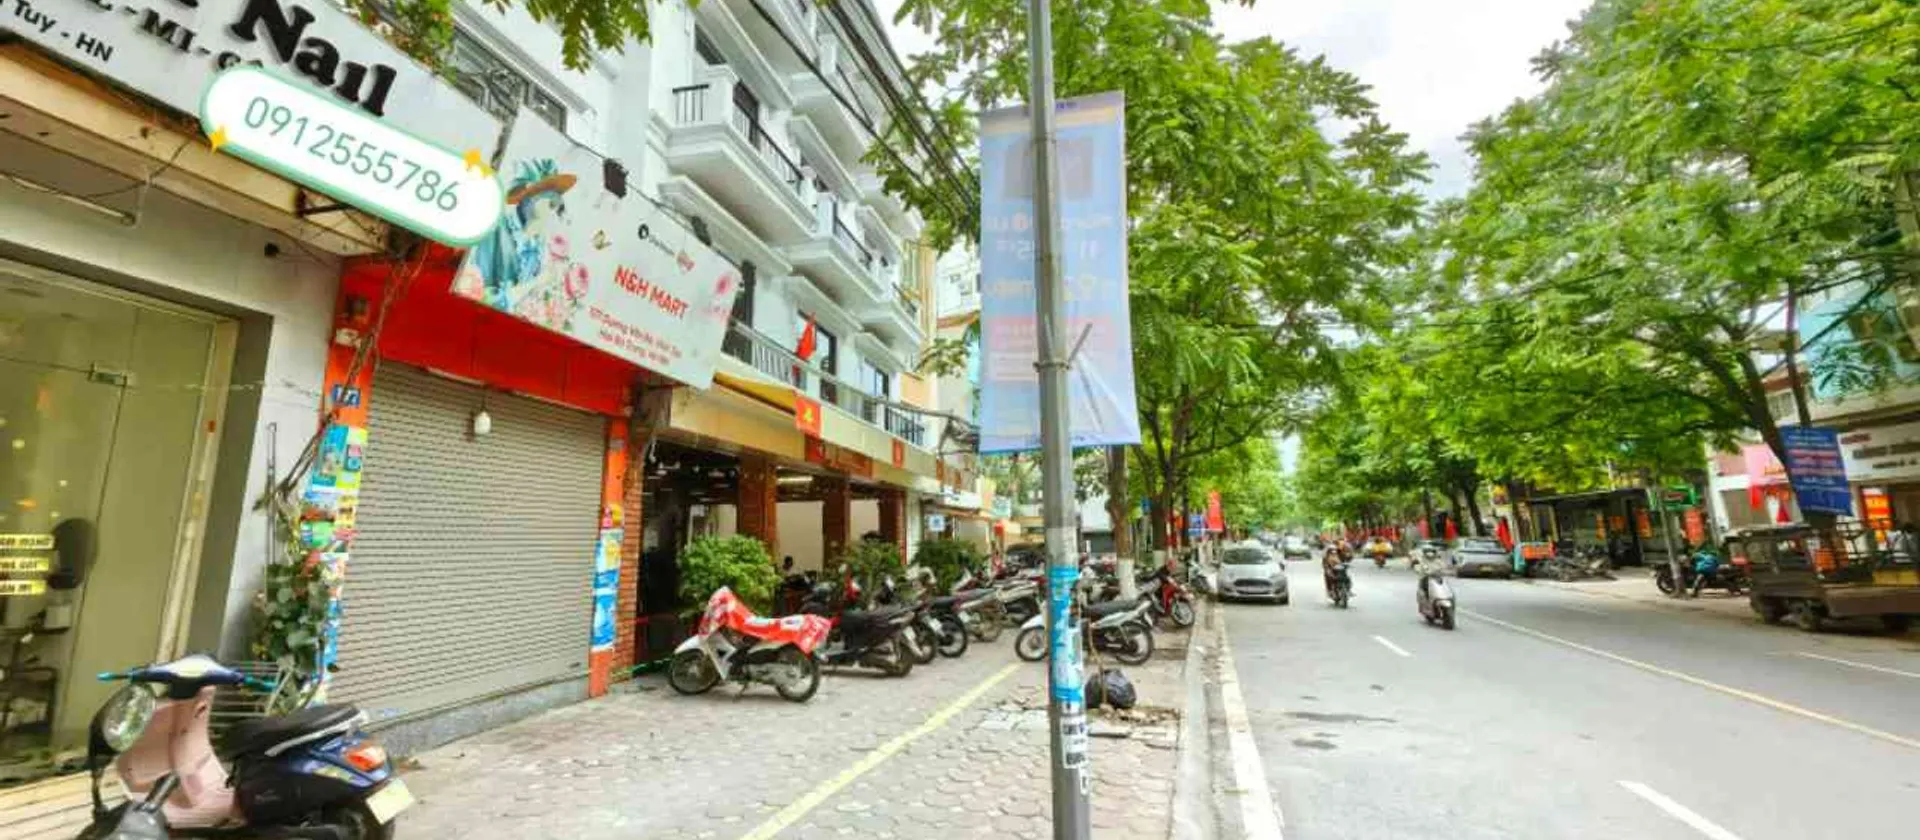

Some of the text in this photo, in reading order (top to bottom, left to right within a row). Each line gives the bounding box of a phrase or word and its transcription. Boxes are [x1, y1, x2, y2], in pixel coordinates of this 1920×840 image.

[75, 31, 114, 62] HN
[141, 8, 196, 52] MI
[231, 0, 397, 117] Nail
[614, 265, 689, 319] N&H MART
